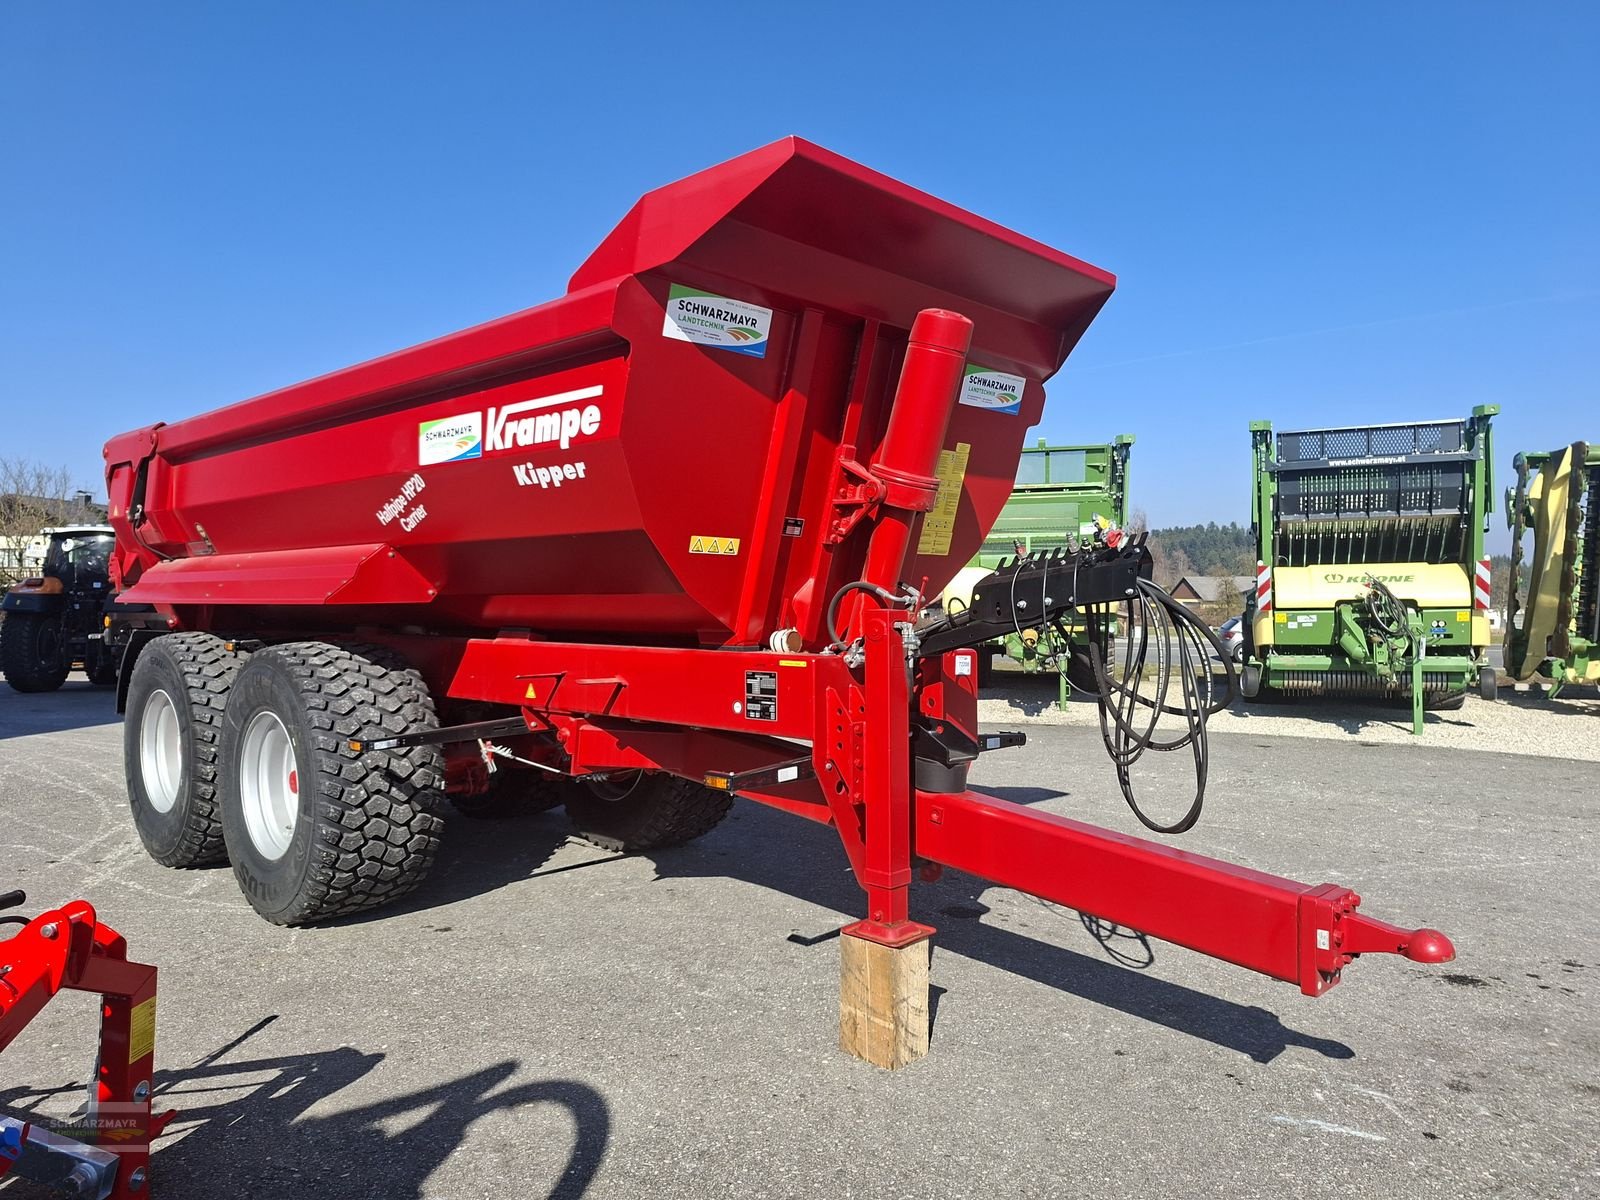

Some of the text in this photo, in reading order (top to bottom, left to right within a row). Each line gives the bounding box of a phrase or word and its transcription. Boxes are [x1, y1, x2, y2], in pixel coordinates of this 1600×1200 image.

[678, 300, 757, 329] SCHWARZMAYR
[678, 314, 725, 331] LANDTECHNIK
[969, 375, 1015, 393] SCHWARZMAYR
[485, 384, 604, 451] Krampe
[425, 425, 473, 442] SCHWARZMAYR
[512, 461, 586, 489] Kipper
[376, 473, 427, 526] Halfpipe HP20
[400, 504, 428, 532] Carrier
